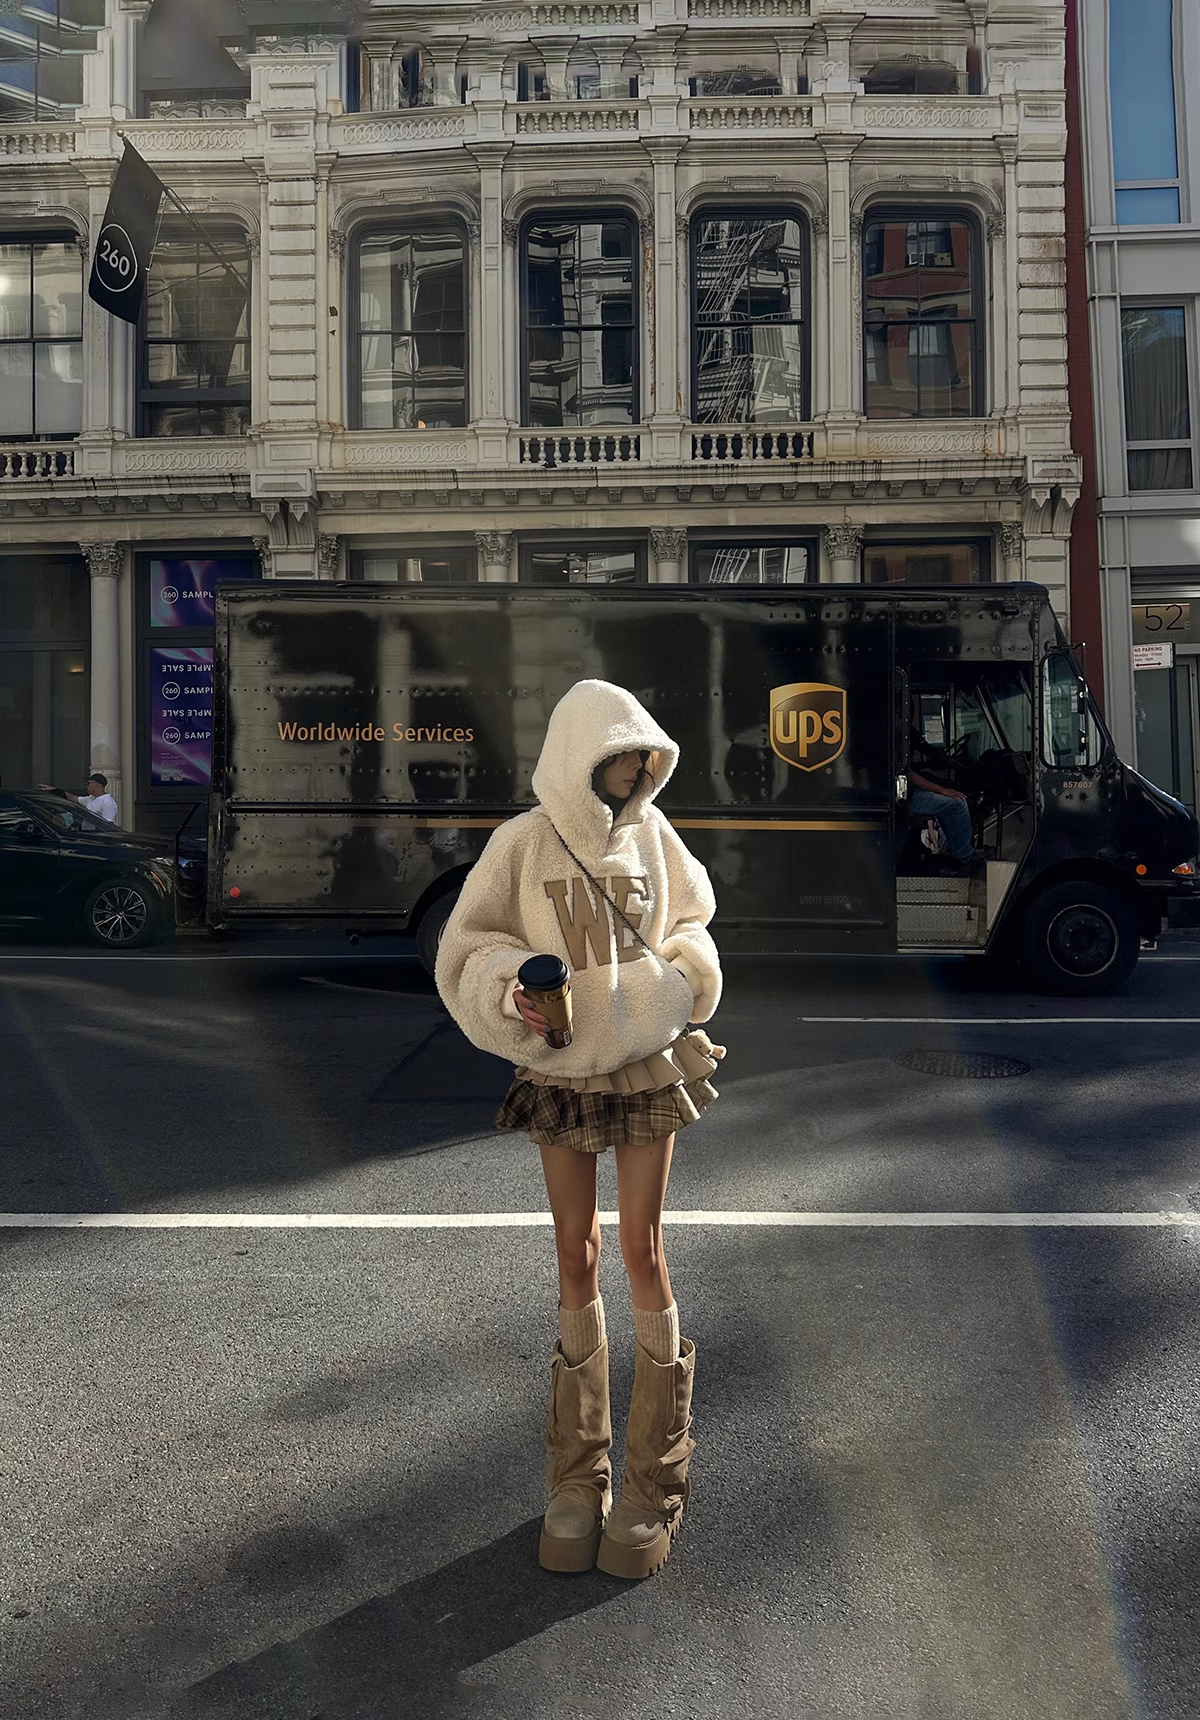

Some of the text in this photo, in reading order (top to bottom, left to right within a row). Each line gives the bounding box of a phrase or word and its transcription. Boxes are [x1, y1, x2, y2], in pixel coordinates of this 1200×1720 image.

[100, 239, 130, 276] 260
[182, 591, 214, 599] SAMPL
[1145, 604, 1184, 631] 52
[161, 664, 214, 672] MPLE SALE
[184, 686, 214, 694] SAMPL
[162, 709, 212, 717] MPLE SALE
[184, 731, 211, 739] SAMP
[278, 721, 474, 743] Worldwide Services
[775, 709, 842, 758] ups
[799, 895, 822, 904] USDOT
[543, 876, 650, 971] WE
